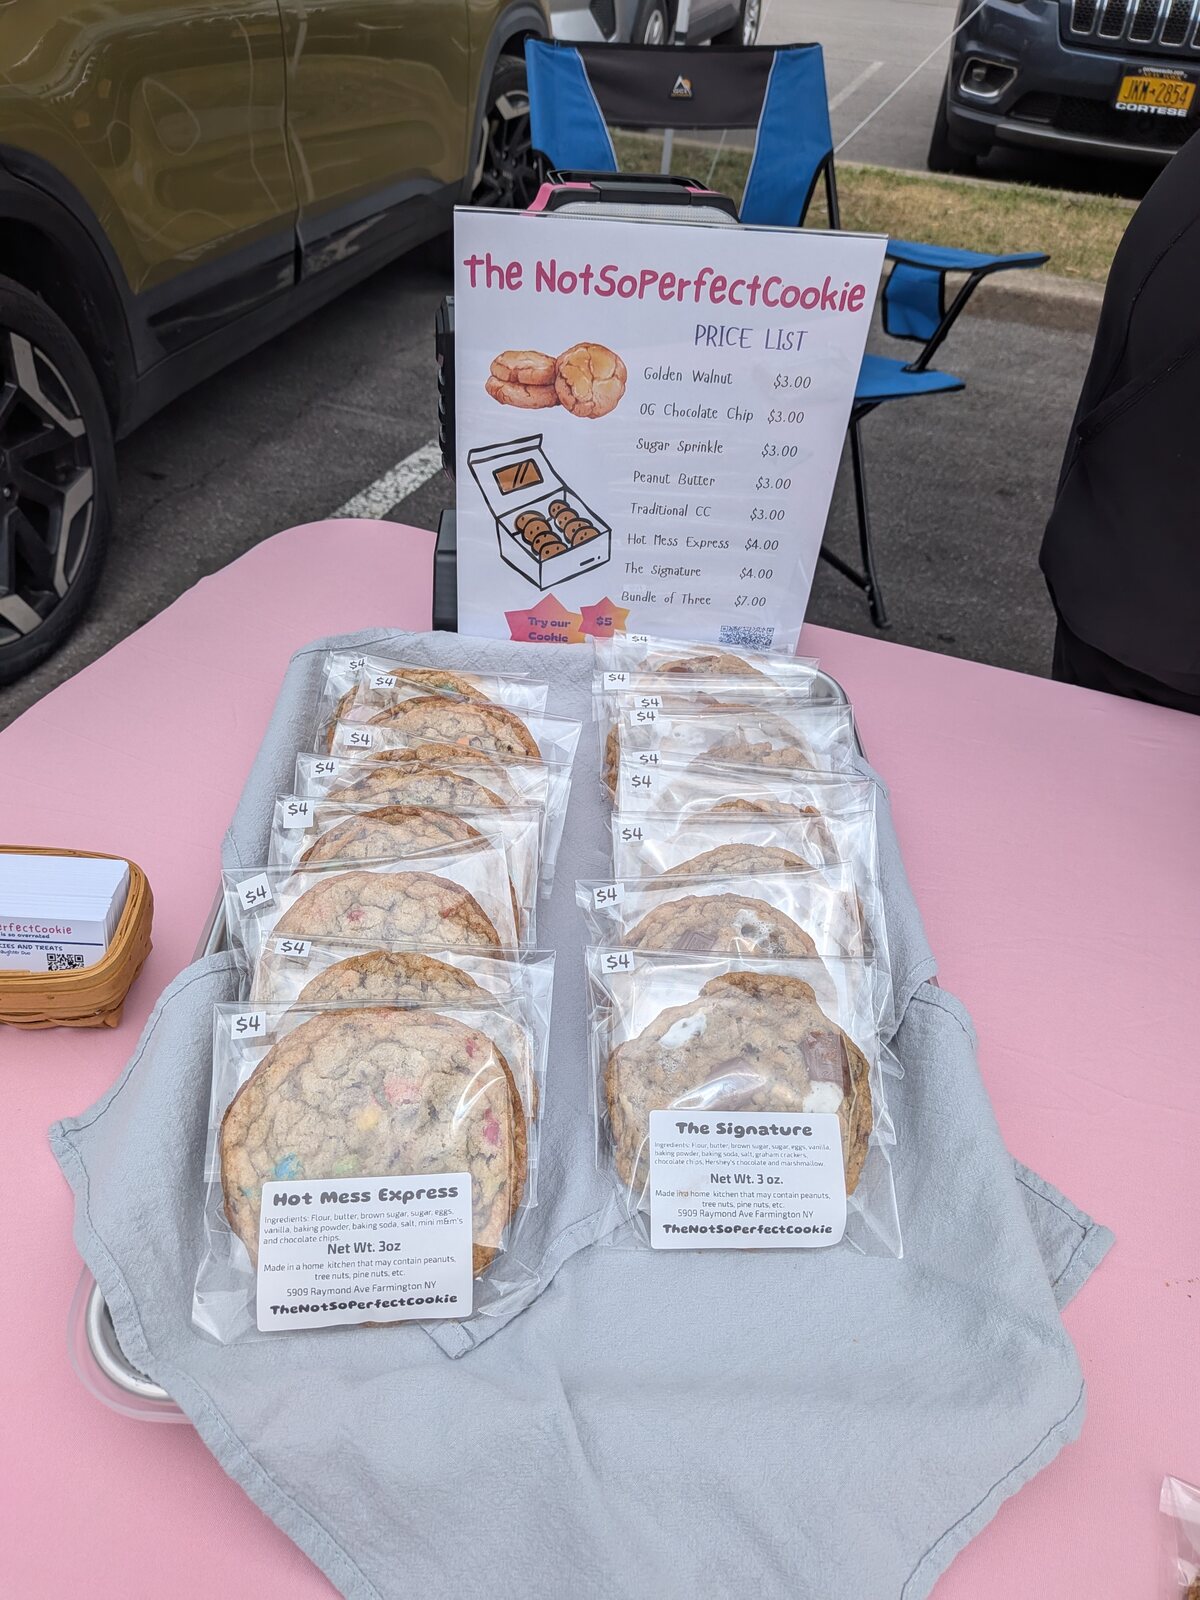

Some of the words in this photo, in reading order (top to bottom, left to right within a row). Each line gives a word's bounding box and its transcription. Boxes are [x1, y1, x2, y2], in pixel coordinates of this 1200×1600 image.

[1115, 102, 1187, 117] CORTESE
[464, 253, 522, 291] the
[536, 260, 866, 312] NotSoPerfectCookie
[695, 325, 751, 349] PRICE
[765, 329, 808, 351] LIST
[644, 367, 683, 383] Golden
[692, 370, 732, 385] Walnut
[773, 375, 811, 389] $3.00
[640, 403, 655, 416] OG
[664, 404, 718, 420] Chocolate
[727, 407, 753, 423] Chip
[767, 410, 804, 424] $3.00
[636, 438, 669, 453] Sugar
[677, 440, 723, 454] Sprinkle
[762, 445, 797, 458] $3.00
[633, 472, 671, 484] Peanut
[678, 473, 715, 487] Butter
[755, 477, 791, 490] $3.00
[631, 503, 688, 517] Traditional
[695, 506, 711, 516] CC
[750, 509, 784, 521] $3.00
[628, 534, 647, 545] Hot
[654, 535, 678, 547] Mess
[686, 537, 729, 551] Express
[745, 539, 779, 551] $4.00
[625, 563, 643, 574] The
[651, 564, 701, 579] Signature
[740, 568, 773, 580] $4.00
[621, 592, 657, 603] Bundle
[664, 592, 674, 604] of
[681, 594, 711, 605] Three
[734, 595, 766, 607] $7.00
[528, 617, 548, 628] Try
[596, 616, 612, 626] $5
[528, 632, 568, 642] Cookie
[632, 635, 648, 643] $4
[349, 659, 365, 670] $4
[375, 677, 393, 687] $4
[608, 673, 625, 682] $4
[641, 698, 660, 707] $4
[637, 711, 656, 721] $4
[350, 732, 370, 746] $4
[640, 754, 659, 764] $4
[315, 762, 335, 774] $4
[632, 775, 652, 788] $4
[288, 802, 308, 816] $4
[622, 827, 643, 840] $4
[245, 886, 267, 904] $4
[597, 889, 617, 902] $4
[281, 941, 305, 955] $4
[606, 954, 630, 970] $4
[235, 1015, 261, 1032] $4
[676, 1122, 710, 1134] The
[716, 1122, 812, 1138] Signature
[710, 1174, 731, 1184] Net
[734, 1174, 754, 1184] Wt.
[757, 1174, 763, 1184] 3
[767, 1176, 783, 1184] oz.
[273, 1192, 312, 1206] Hot
[320, 1191, 370, 1204] Mess
[379, 1187, 458, 1204] Express
[756, 1192, 771, 1200] may
[800, 1192, 830, 1200] peanuts,
[311, 1214, 331, 1222] Flour,
[334, 1213, 358, 1221] butter,
[387, 1211, 408, 1219] sugar,
[677, 1209, 697, 1218] 5909
[699, 1210, 737, 1218] Raymond
[739, 1210, 753, 1218] Ave
[755, 1210, 801, 1219] Farmington
[264, 1225, 291, 1234] vanilla,
[294, 1225, 318, 1233] baking
[320, 1224, 350, 1232] powder,
[352, 1222, 377, 1231] baking
[401, 1220, 416, 1228] salt,
[663, 1224, 832, 1234] TheNotSoPerfectCookie
[264, 1236, 278, 1244] and
[280, 1235, 317, 1243] chocolate
[319, 1234, 340, 1243] chips.
[328, 1243, 350, 1254] Net
[354, 1242, 375, 1254] Wt.
[379, 1241, 401, 1252] 3oz
[264, 1263, 285, 1272] Made
[302, 1262, 324, 1270] home
[328, 1260, 355, 1268] kitchen
[357, 1259, 373, 1267] that
[375, 1259, 391, 1268] may
[393, 1257, 422, 1266] contain
[424, 1256, 456, 1264] peanuts,
[332, 1272, 351, 1280] nuts,
[352, 1271, 369, 1280] pine
[287, 1288, 308, 1297] 5909
[311, 1286, 352, 1296] Raymond
[373, 1283, 422, 1294] Farmington
[424, 1281, 436, 1289] NY
[270, 1294, 458, 1315] TheNotSoPerfectCookie
